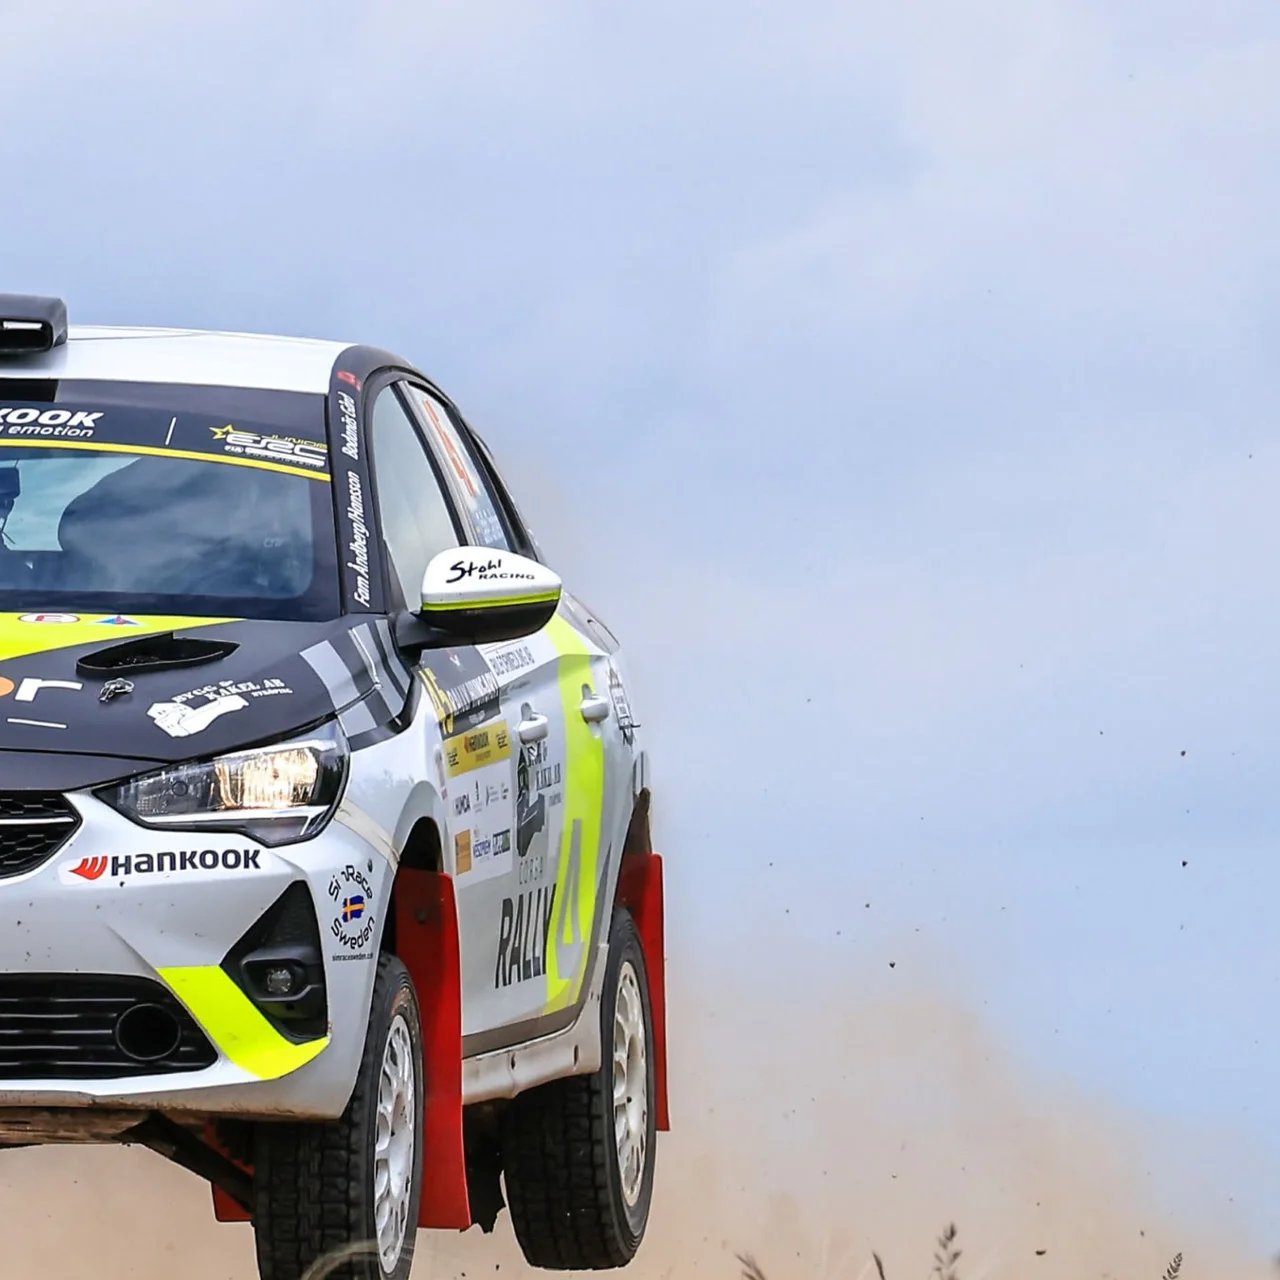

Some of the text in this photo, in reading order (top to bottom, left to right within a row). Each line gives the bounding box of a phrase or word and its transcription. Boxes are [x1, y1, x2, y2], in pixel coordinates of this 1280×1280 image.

[8, 425, 94, 437] emotion
[445, 559, 502, 583] Stohl
[171, 684, 218, 703] BYGG
[204, 678, 286, 701] KAKEL AB
[331, 916, 375, 949] Sweden
[495, 882, 557, 989] RALLY
